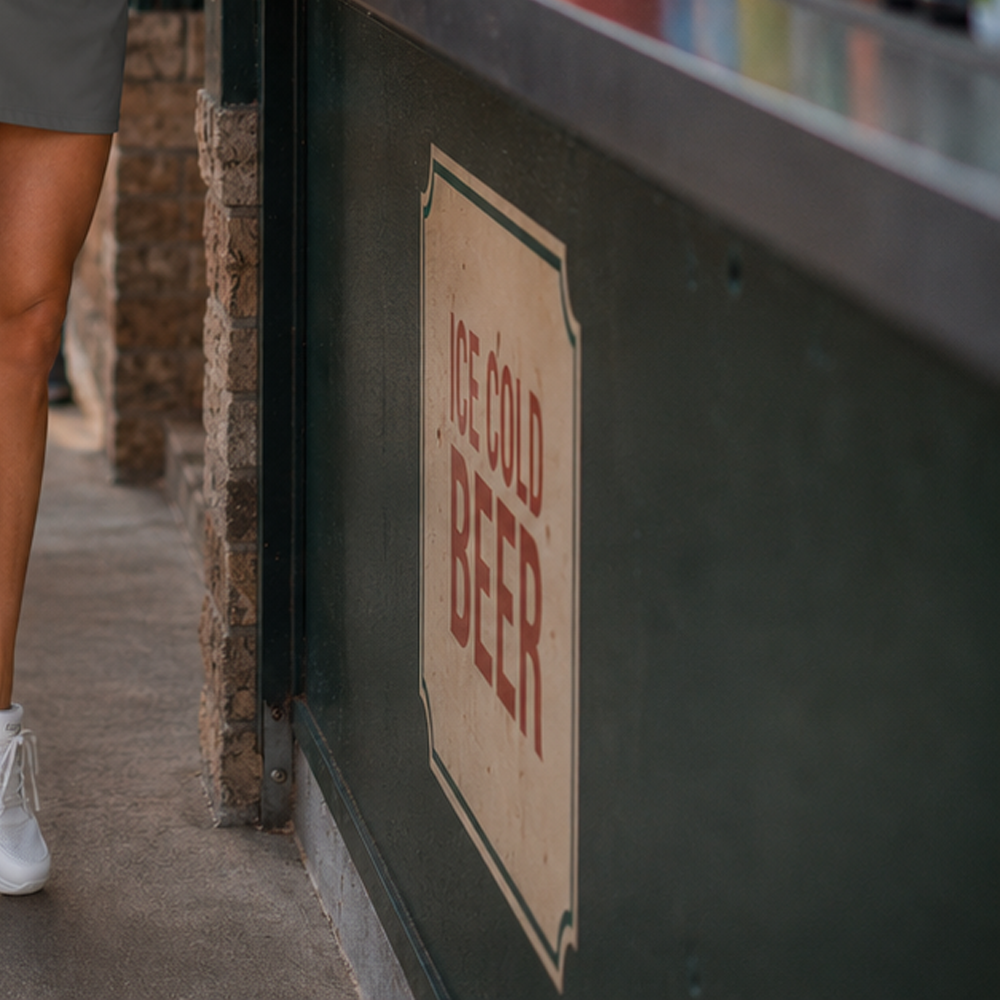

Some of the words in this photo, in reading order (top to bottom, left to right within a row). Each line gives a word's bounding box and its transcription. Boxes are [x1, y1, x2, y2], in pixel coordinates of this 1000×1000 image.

[449, 311, 480, 453] ICE
[486, 348, 544, 519] COLD
[449, 442, 544, 764] BEER
